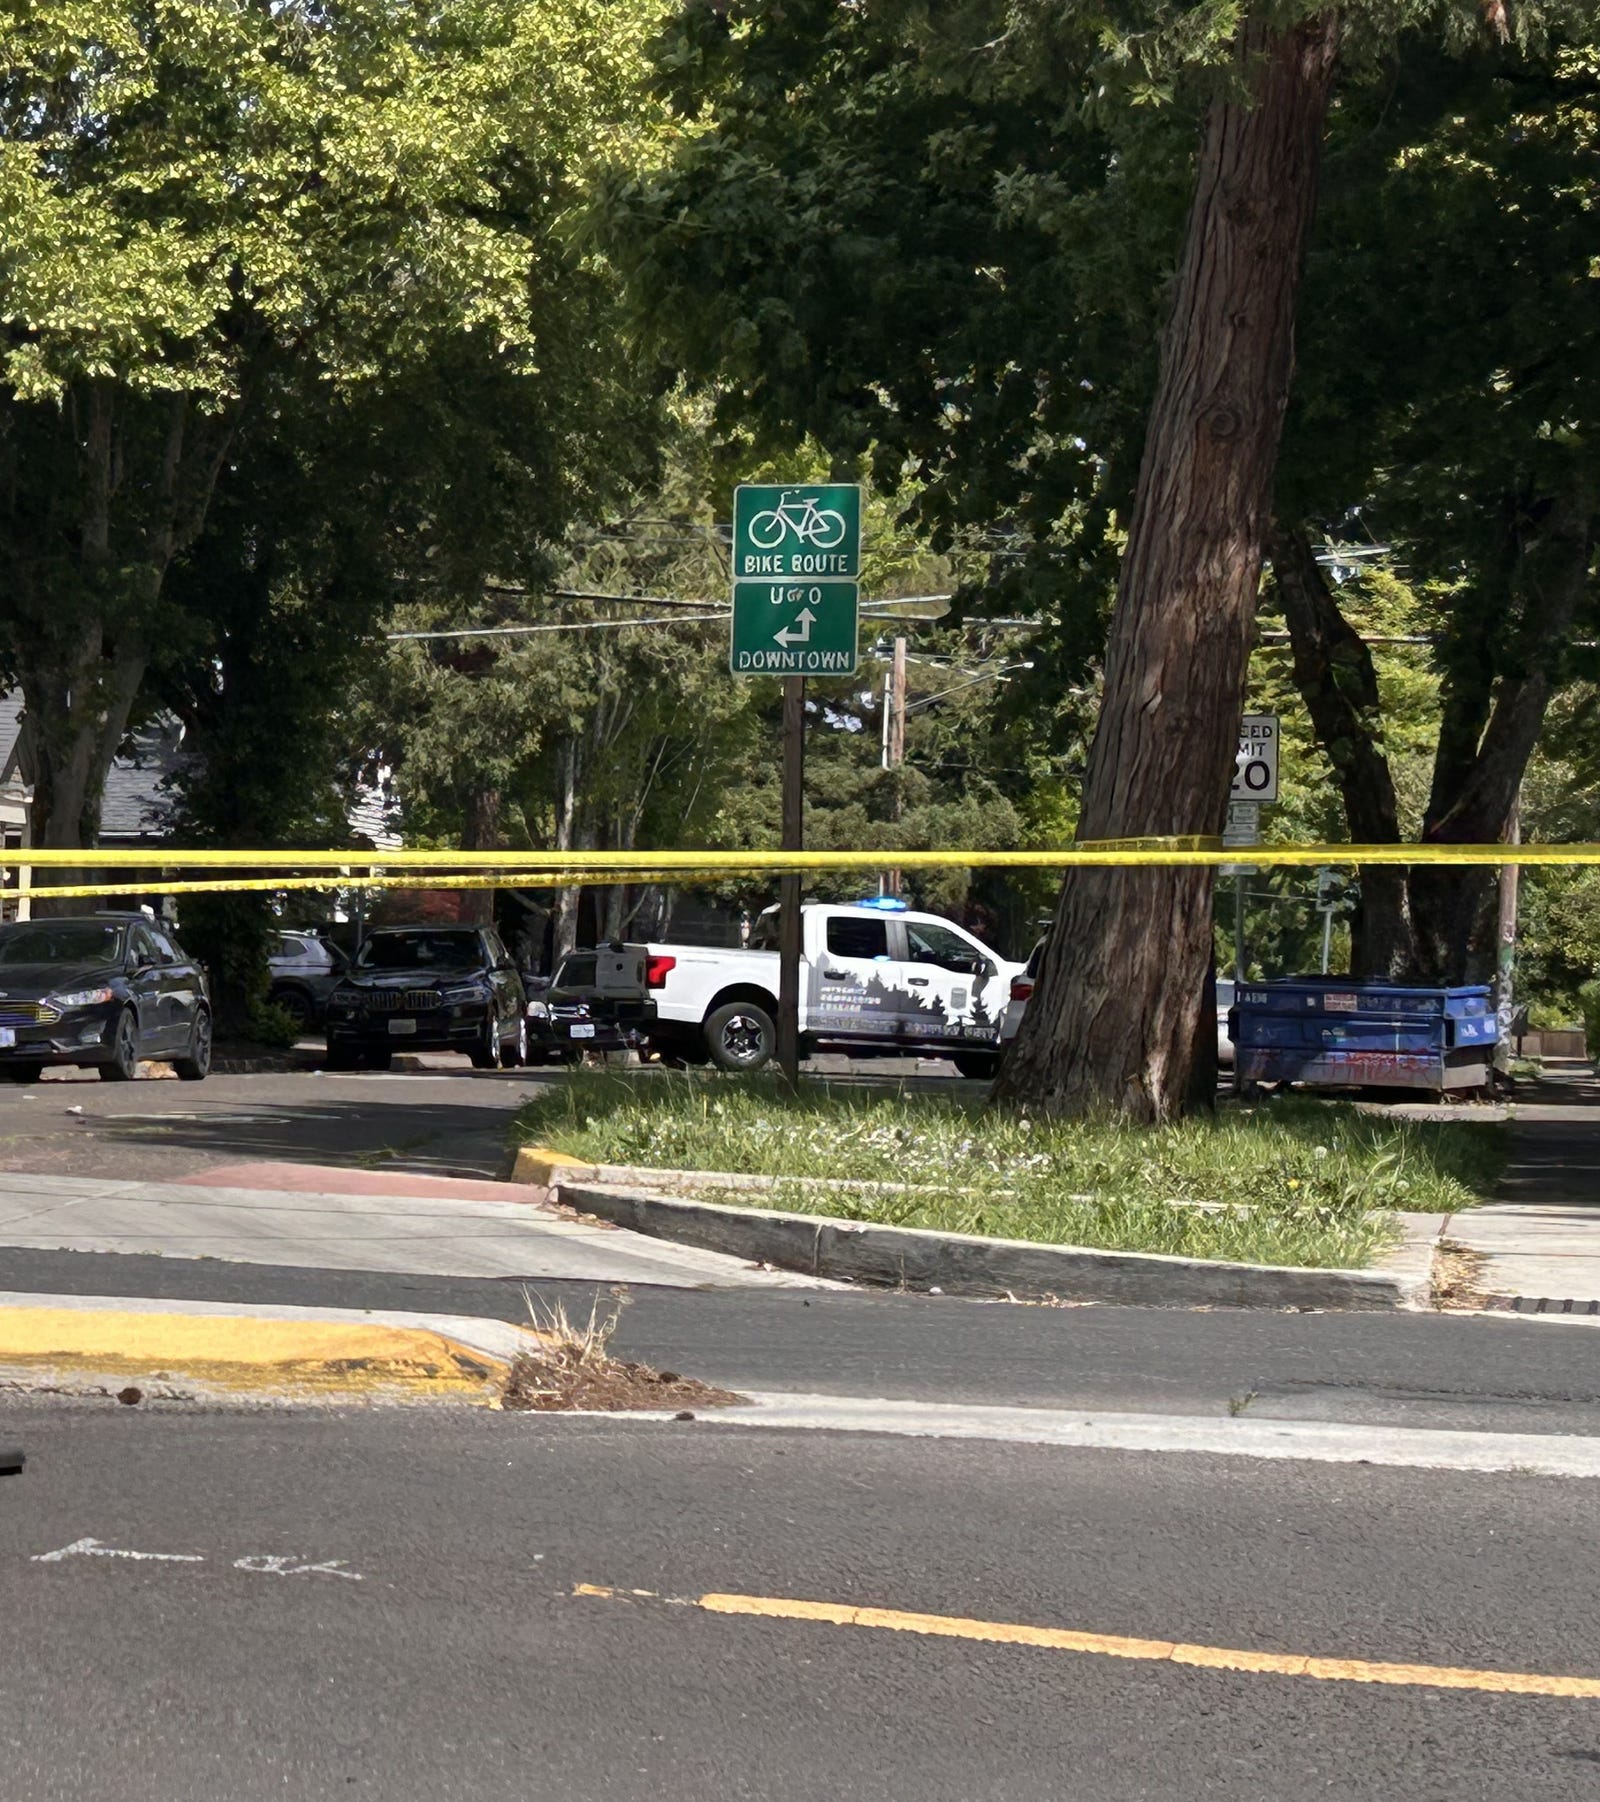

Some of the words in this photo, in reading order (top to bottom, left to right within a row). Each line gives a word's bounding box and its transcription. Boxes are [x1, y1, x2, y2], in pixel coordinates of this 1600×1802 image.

[744, 554, 784, 573] BIKE
[791, 554, 848, 573] ROUTE
[770, 586, 784, 604] U
[809, 586, 821, 604] O
[739, 650, 849, 670] DOWNTOWN
[1240, 725, 1273, 738] EED
[1238, 743, 1266, 756] MIT
